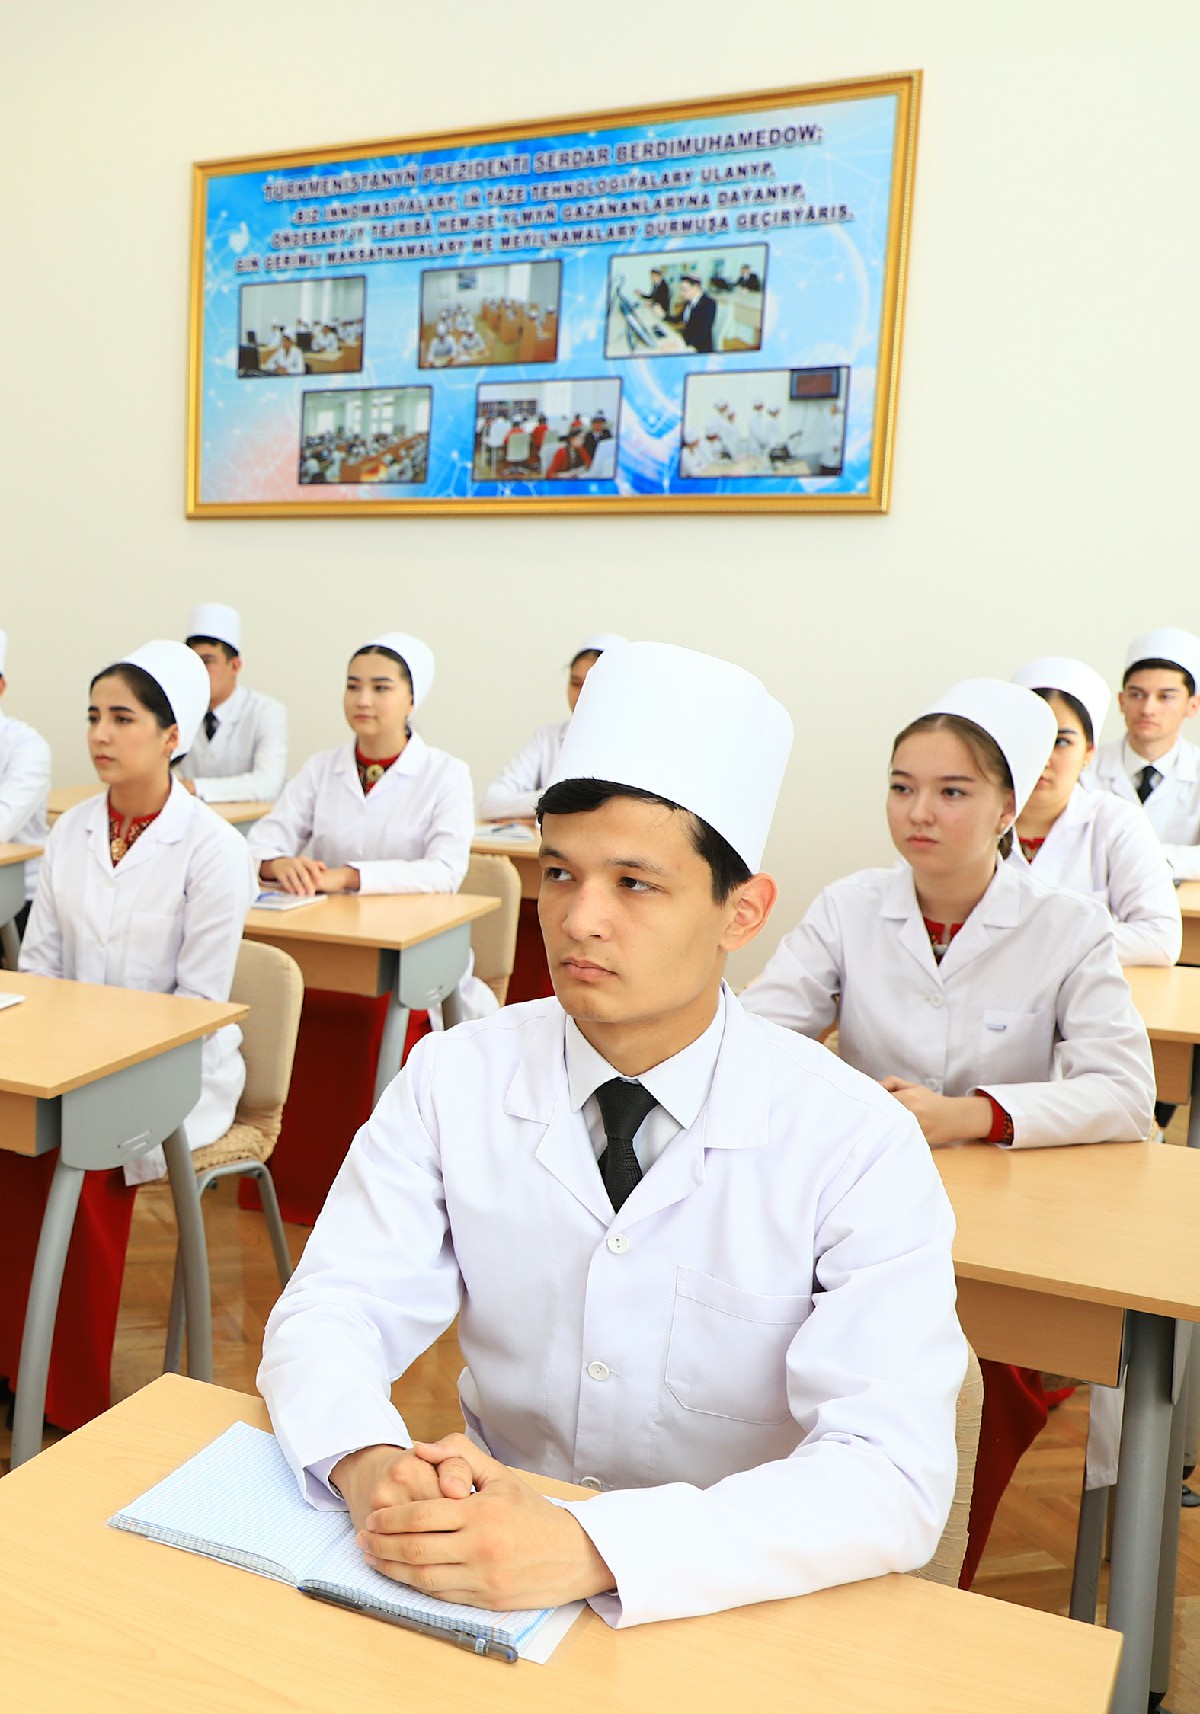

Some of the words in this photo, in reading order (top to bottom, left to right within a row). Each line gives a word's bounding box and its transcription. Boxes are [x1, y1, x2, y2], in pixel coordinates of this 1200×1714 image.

[422, 154, 530, 184] PREZIDENTI
[533, 146, 610, 173] SERDAR
[615, 123, 823, 164] BERDIMUHAMEDOW:
[700, 160, 776, 185] ULANYP,
